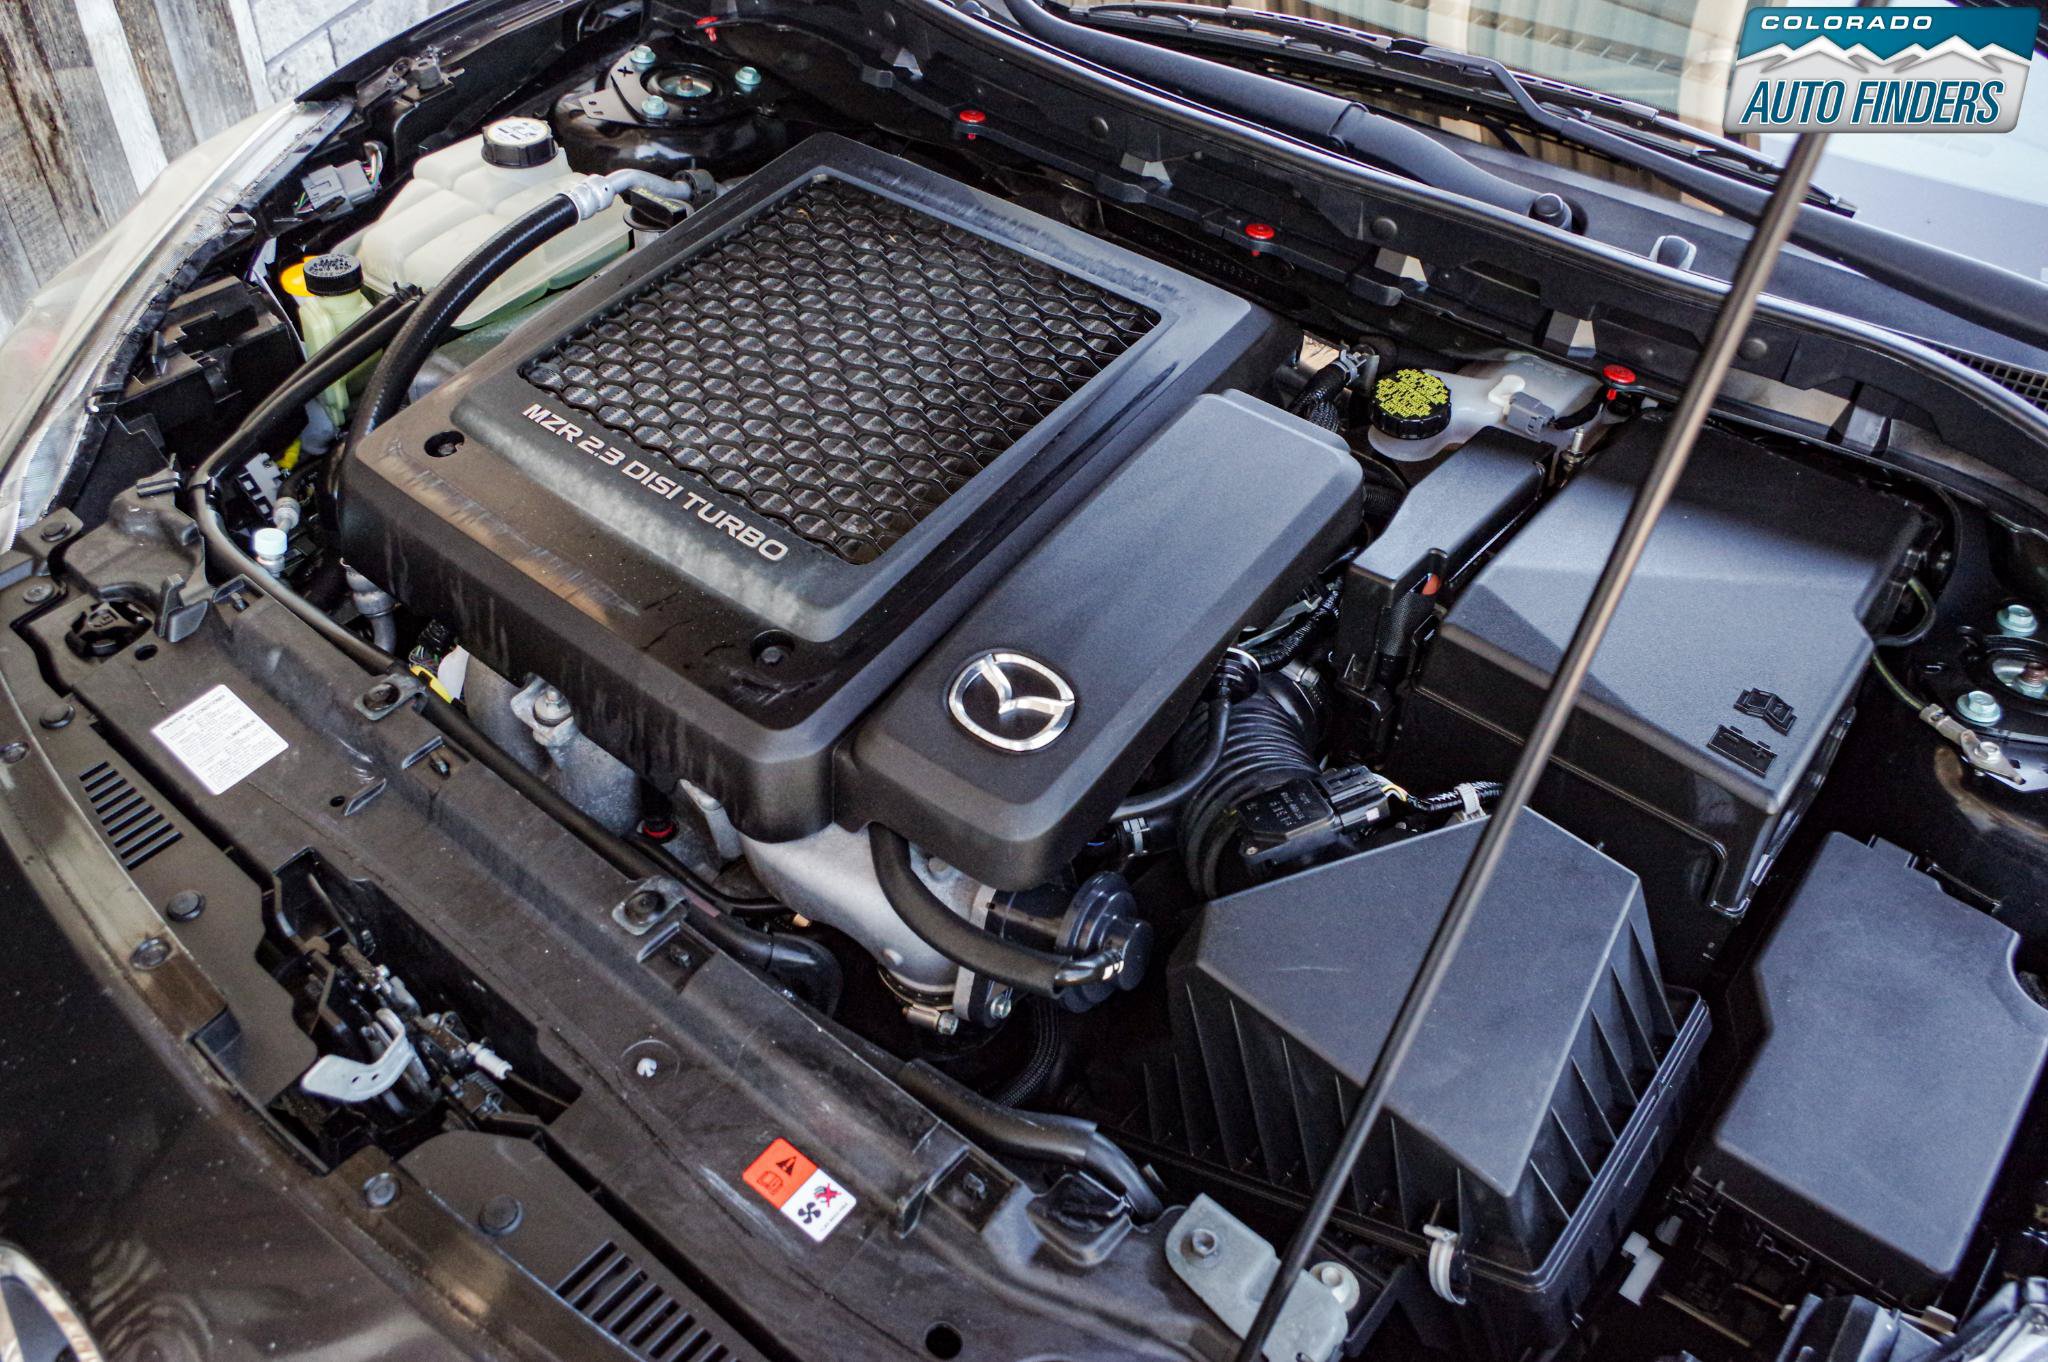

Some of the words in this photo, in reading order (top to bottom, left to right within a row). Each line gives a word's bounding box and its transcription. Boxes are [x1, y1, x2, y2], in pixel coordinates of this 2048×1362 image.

[522, 403, 584, 442] MZR
[577, 435, 626, 466] 2.3
[622, 459, 685, 500] DISI
[682, 491, 789, 562] TURBO
